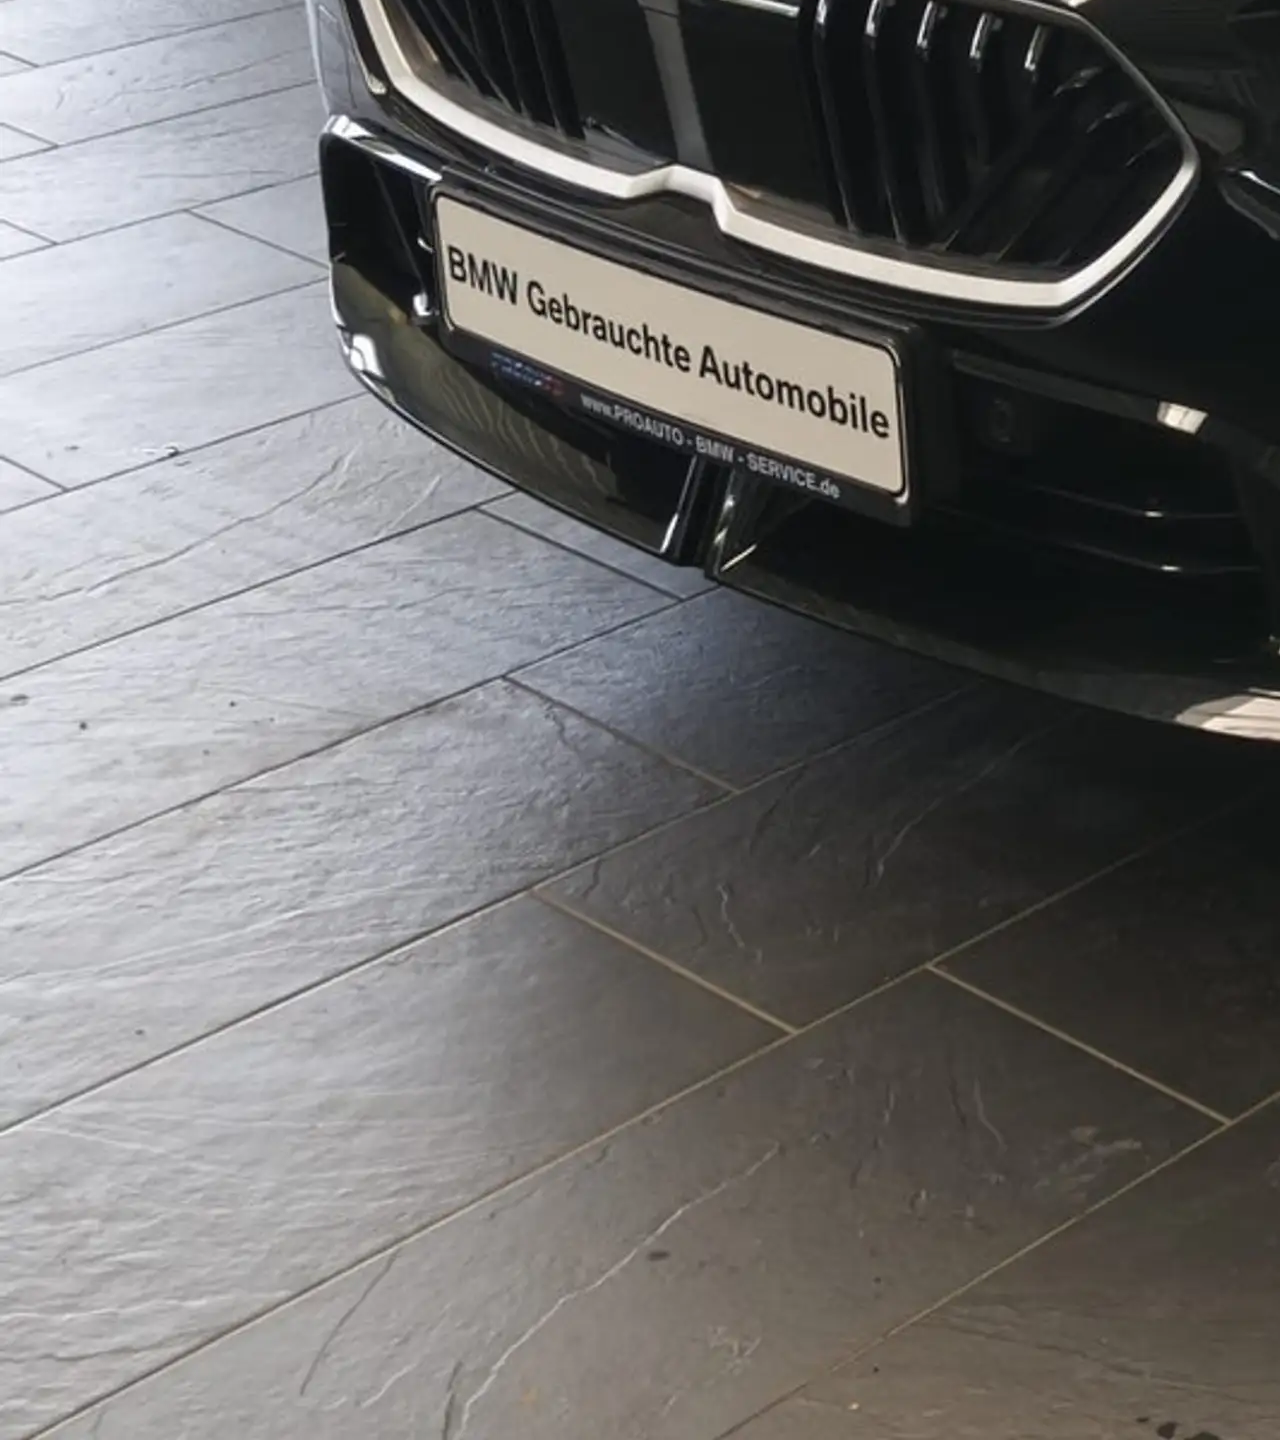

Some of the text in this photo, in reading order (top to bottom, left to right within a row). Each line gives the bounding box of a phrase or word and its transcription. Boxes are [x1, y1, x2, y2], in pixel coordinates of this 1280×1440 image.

[447, 244, 890, 439] BMW Gebrauchte Automobile
[695, 435, 735, 463] BMW
[746, 451, 841, 500] SERVICE.de
